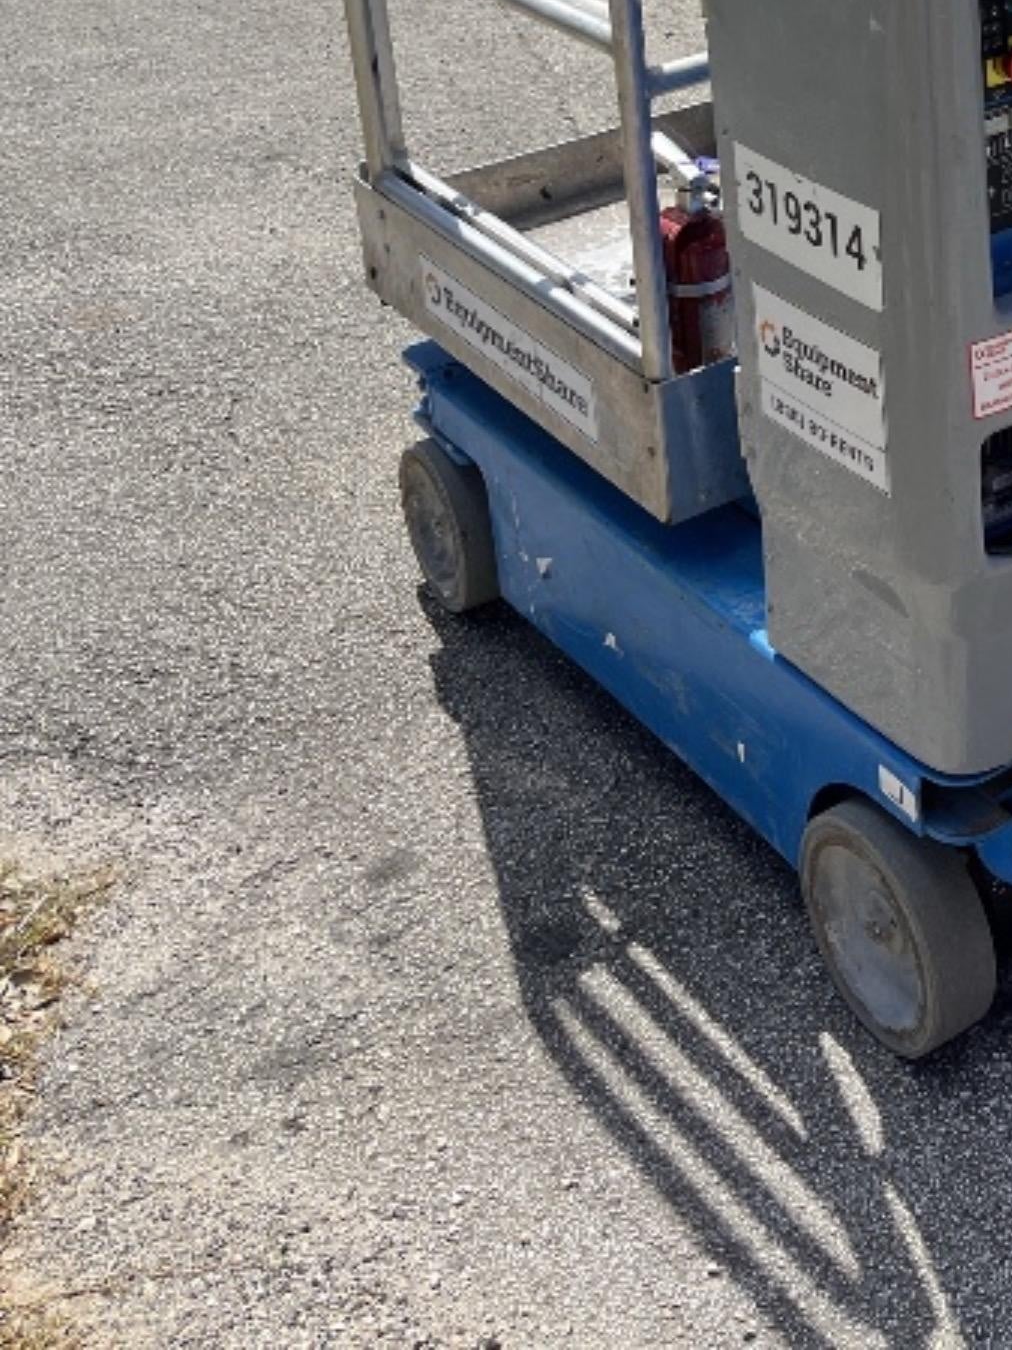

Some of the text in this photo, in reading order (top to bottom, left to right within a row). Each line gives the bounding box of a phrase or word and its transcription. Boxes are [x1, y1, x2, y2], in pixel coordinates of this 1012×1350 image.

[746, 170, 866, 271] 319314
[782, 325, 880, 401] Equipment
[782, 350, 832, 397] Share
